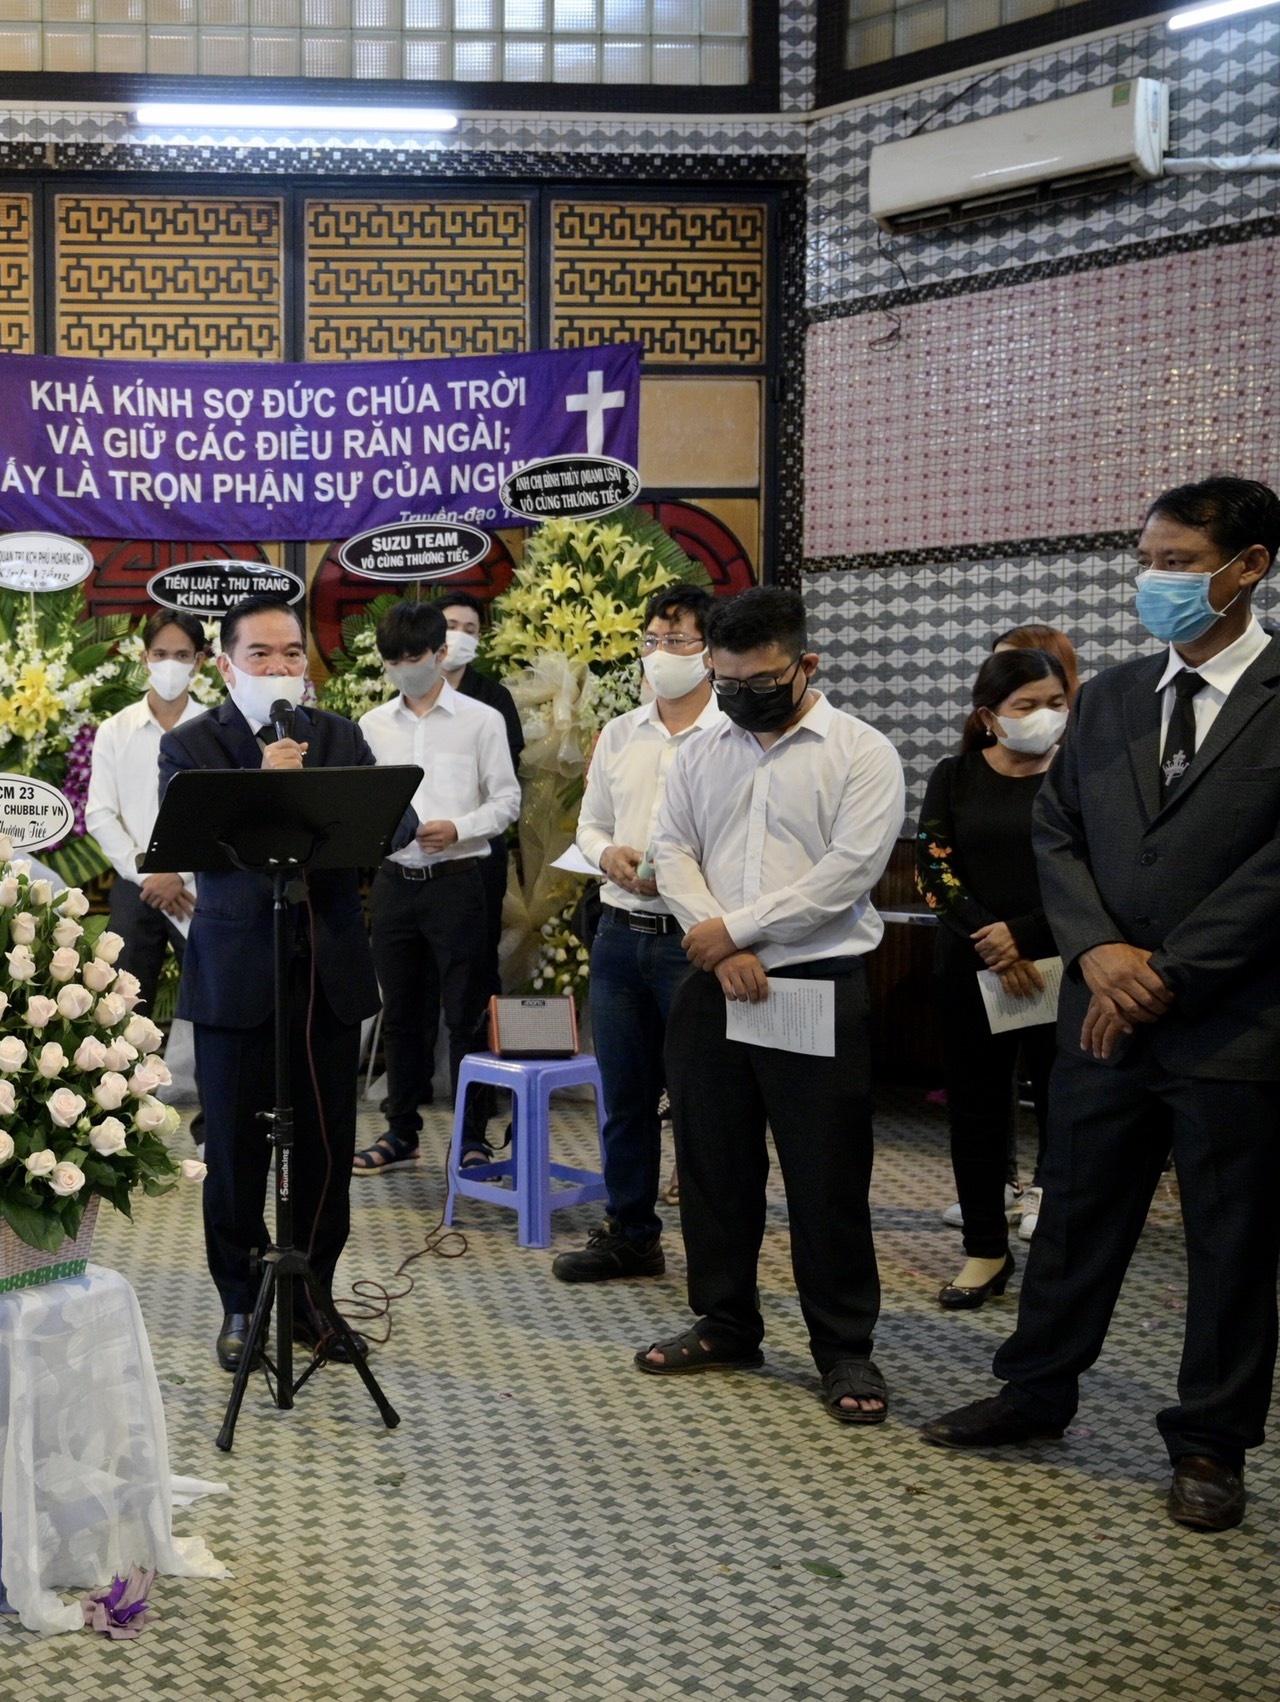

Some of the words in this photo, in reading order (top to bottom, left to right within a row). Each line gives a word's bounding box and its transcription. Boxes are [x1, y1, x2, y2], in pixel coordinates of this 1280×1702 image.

[29, 375, 104, 416] KHÁ
[112, 378, 194, 419] KÍNH
[203, 386, 255, 427] SỢ
[261, 380, 336, 420] ĐỨC
[346, 376, 441, 418] CHÚA
[447, 370, 527, 411] TRỜI
[46, 418, 95, 457] VÀ
[103, 421, 167, 461] GIỮ
[175, 423, 246, 462] CÁC
[255, 423, 332, 461] ĐIỀU
[343, 420, 412, 460] RĂN
[423, 414, 512, 455] NGÀI;
[0, 456, 47, 496] ẤY
[55, 461, 100, 500] LÀ
[109, 470, 202, 510] TRỌN
[213, 467, 304, 511] PHẬN
[314, 470, 363, 509] SỰ
[372, 461, 443, 500] CỦA
[520, 494, 534, 512] VÔ
[535, 492, 561, 511] CÙNG
[561, 490, 599, 508] THƯƠNG
[599, 483, 622, 505] TIẾC
[372, 535, 411, 552] SUZU
[415, 532, 458, 549] TEAM
[361, 554, 375, 570] VÔ
[377, 552, 404, 568] CÙNG
[406, 550, 445, 567] THƯƠNG
[447, 546, 470, 563] TIẾC
[191, 575, 219, 593] LUẬT
[228, 577, 250, 591] THU
[252, 577, 290, 591] TRANG
[176, 591, 218, 606] KÍNH
[19, 786, 35, 799] 23
[4, 804, 49, 816] CHUBBLIF
[52, 805, 64, 816] VN
